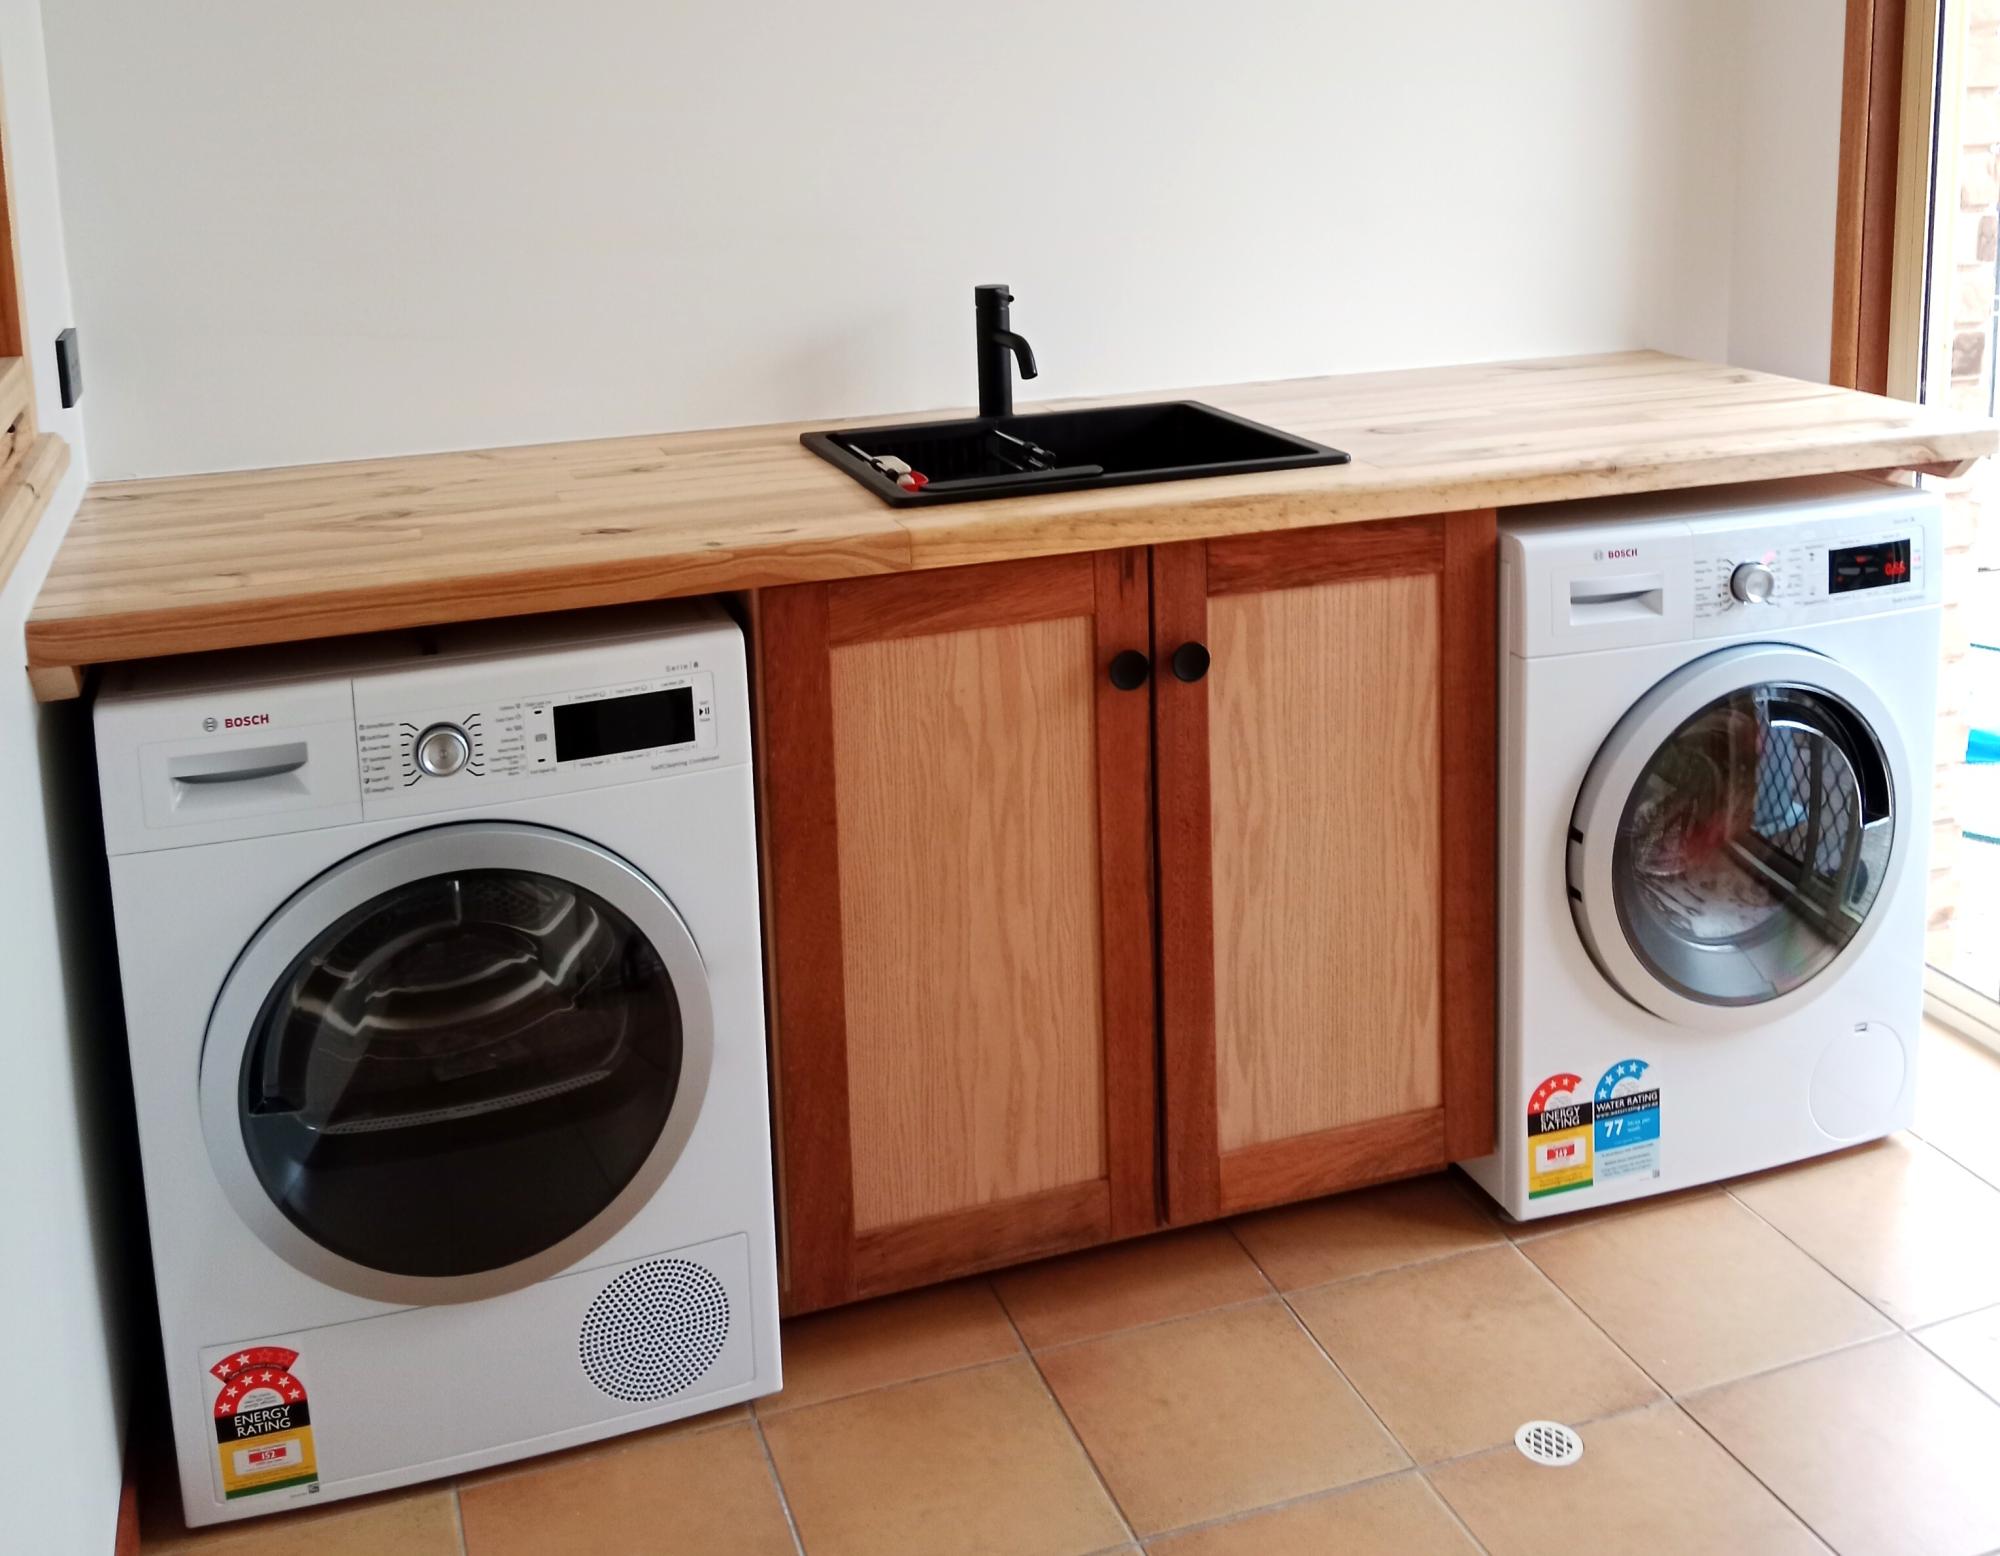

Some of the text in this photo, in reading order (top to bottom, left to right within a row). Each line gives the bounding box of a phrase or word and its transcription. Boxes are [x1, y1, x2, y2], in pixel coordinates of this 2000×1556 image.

[1607, 547, 1639, 560] BOSCH
[225, 714, 270, 728] BOSCH
[1596, 1091, 1658, 1112] WATER RATING
[1540, 1105, 1580, 1123] ENERGY
[1540, 1115, 1581, 1133] RATING
[1604, 1118, 1624, 1138] 77
[234, 1405, 291, 1427] ENERGY
[237, 1417, 291, 1438] RATING
[261, 1451, 276, 1460] 152
